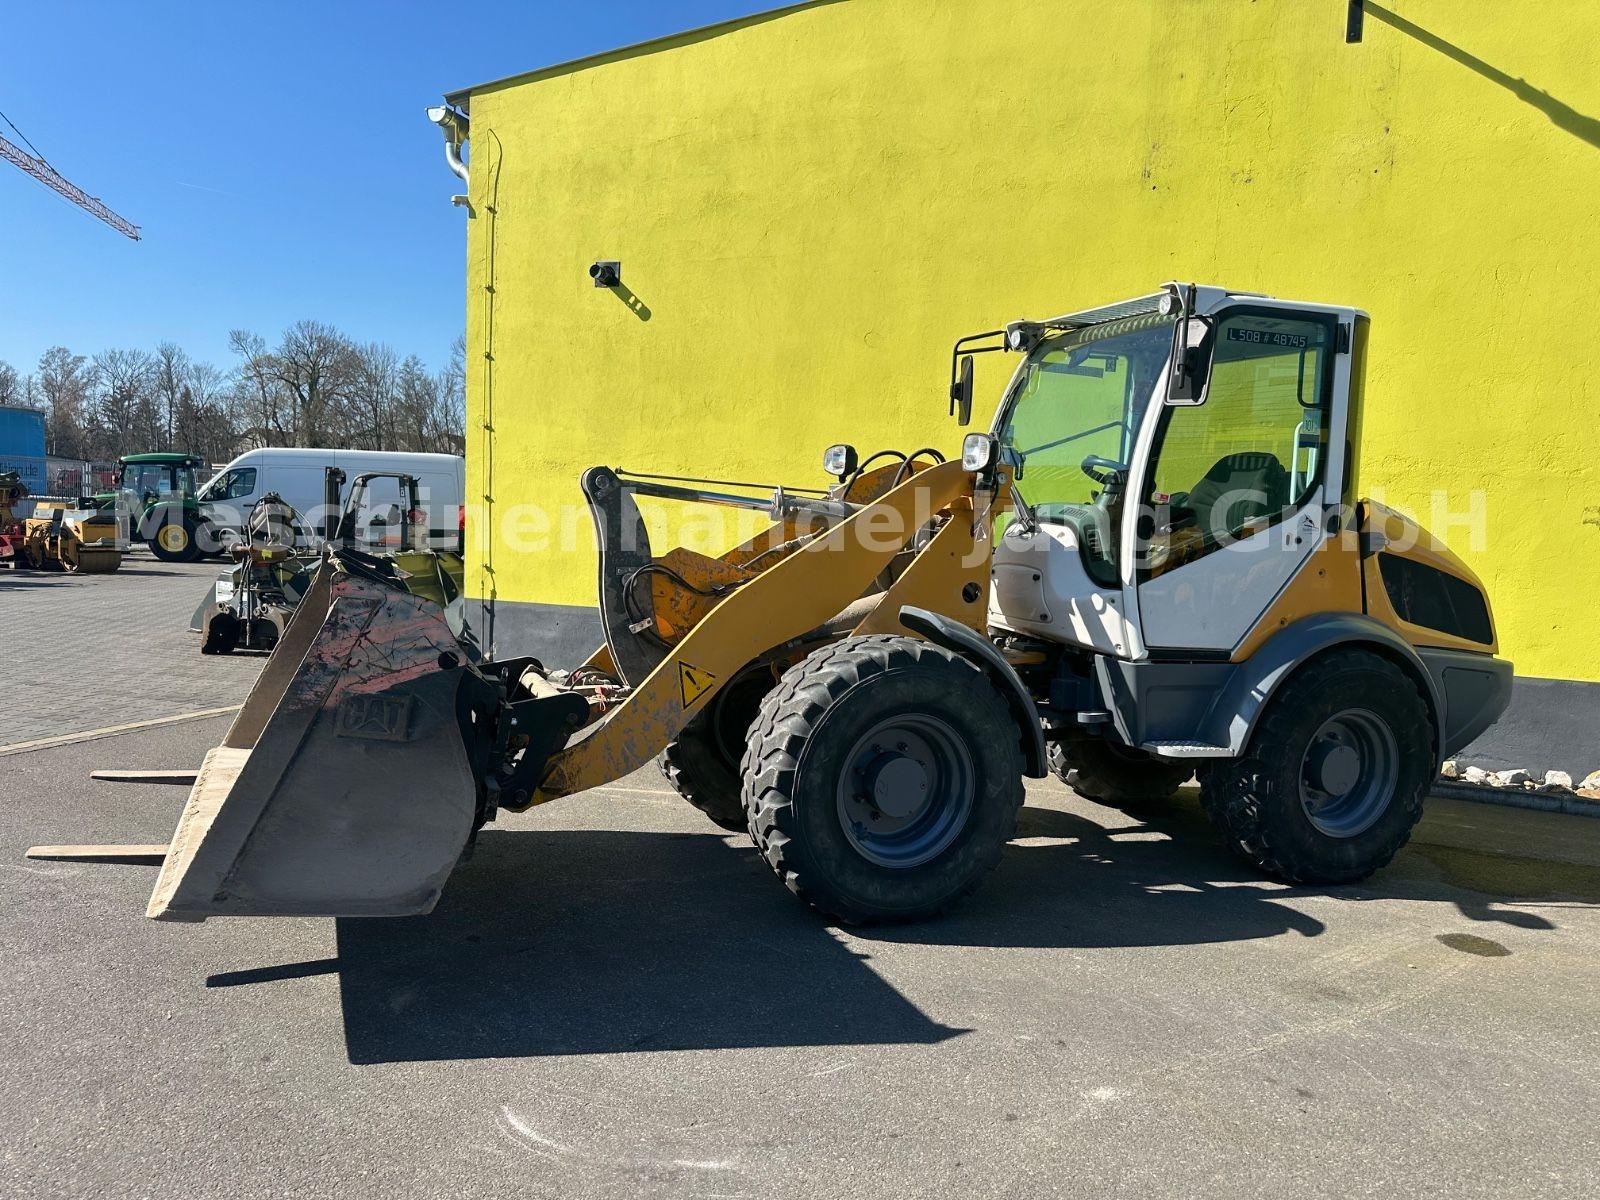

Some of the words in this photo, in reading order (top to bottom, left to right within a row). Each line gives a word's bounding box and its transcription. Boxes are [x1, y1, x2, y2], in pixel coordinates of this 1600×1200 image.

[1229, 328, 1237, 340] L
[1240, 329, 1260, 343] 508
[1273, 333, 1306, 348] 48745
